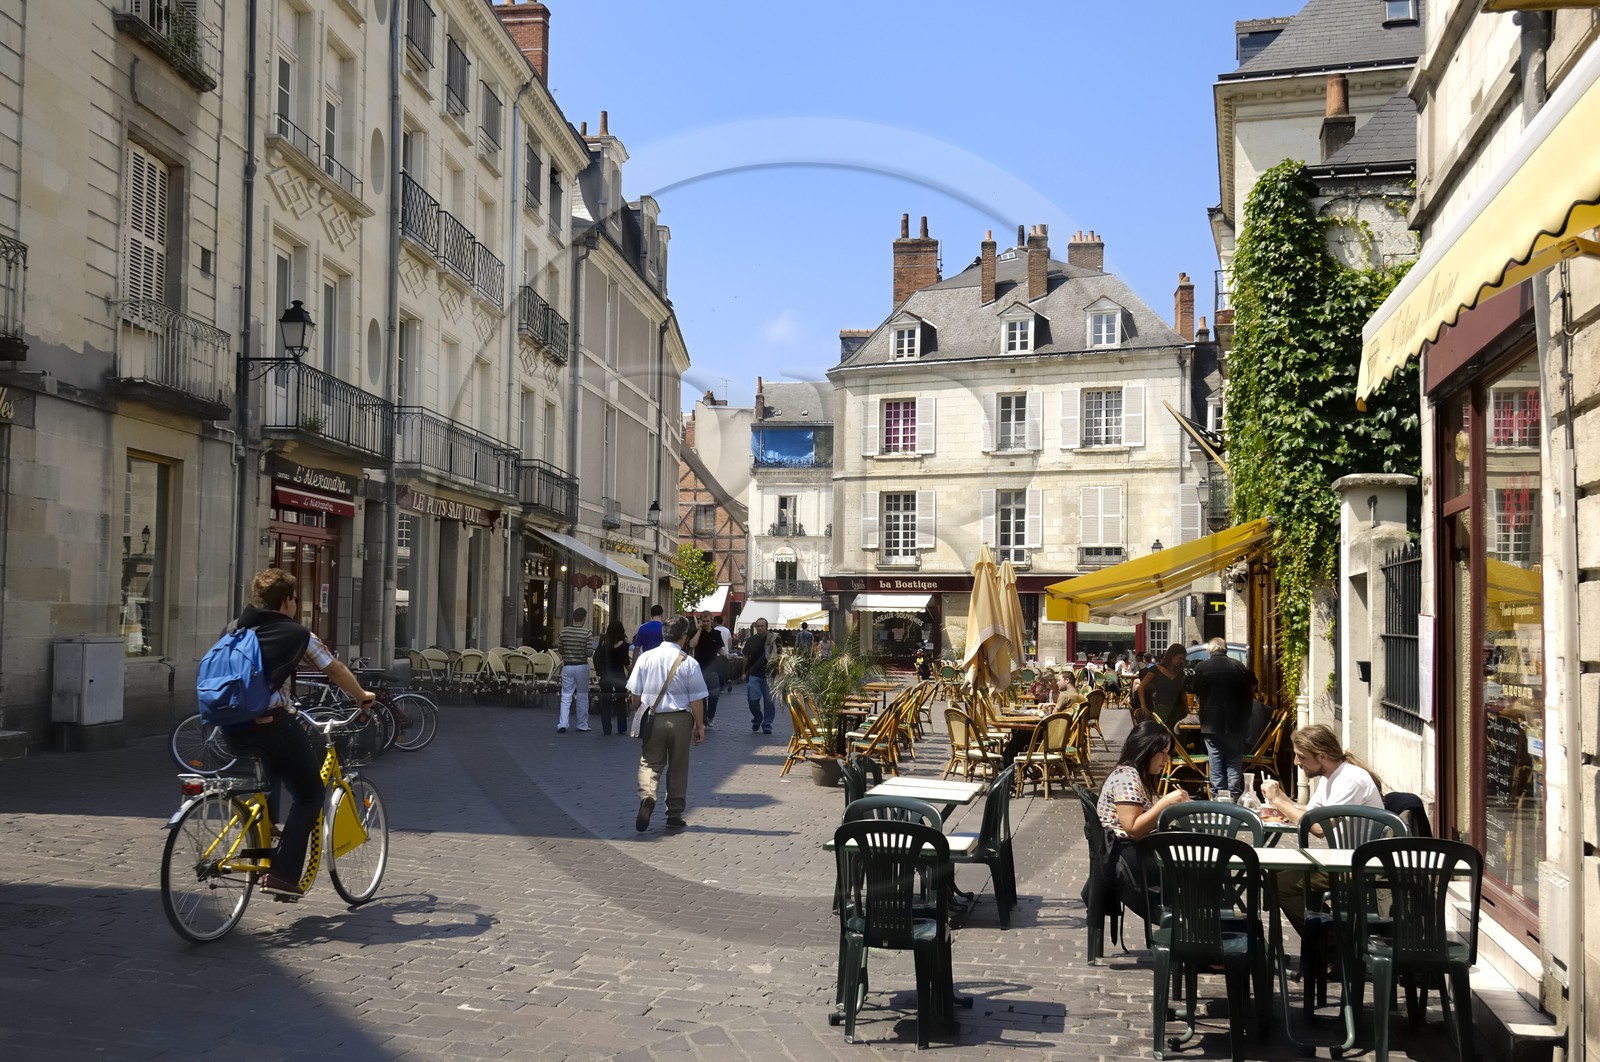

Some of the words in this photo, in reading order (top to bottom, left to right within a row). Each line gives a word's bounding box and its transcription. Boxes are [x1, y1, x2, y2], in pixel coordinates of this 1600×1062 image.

[293, 466, 346, 494] L'Alexandra
[412, 492, 425, 511] LE
[426, 496, 447, 516] PUITS
[447, 501, 463, 519] SAIT
[464, 504, 481, 523] TOUT
[879, 580, 891, 589] La
[895, 580, 938, 589] Boutique
